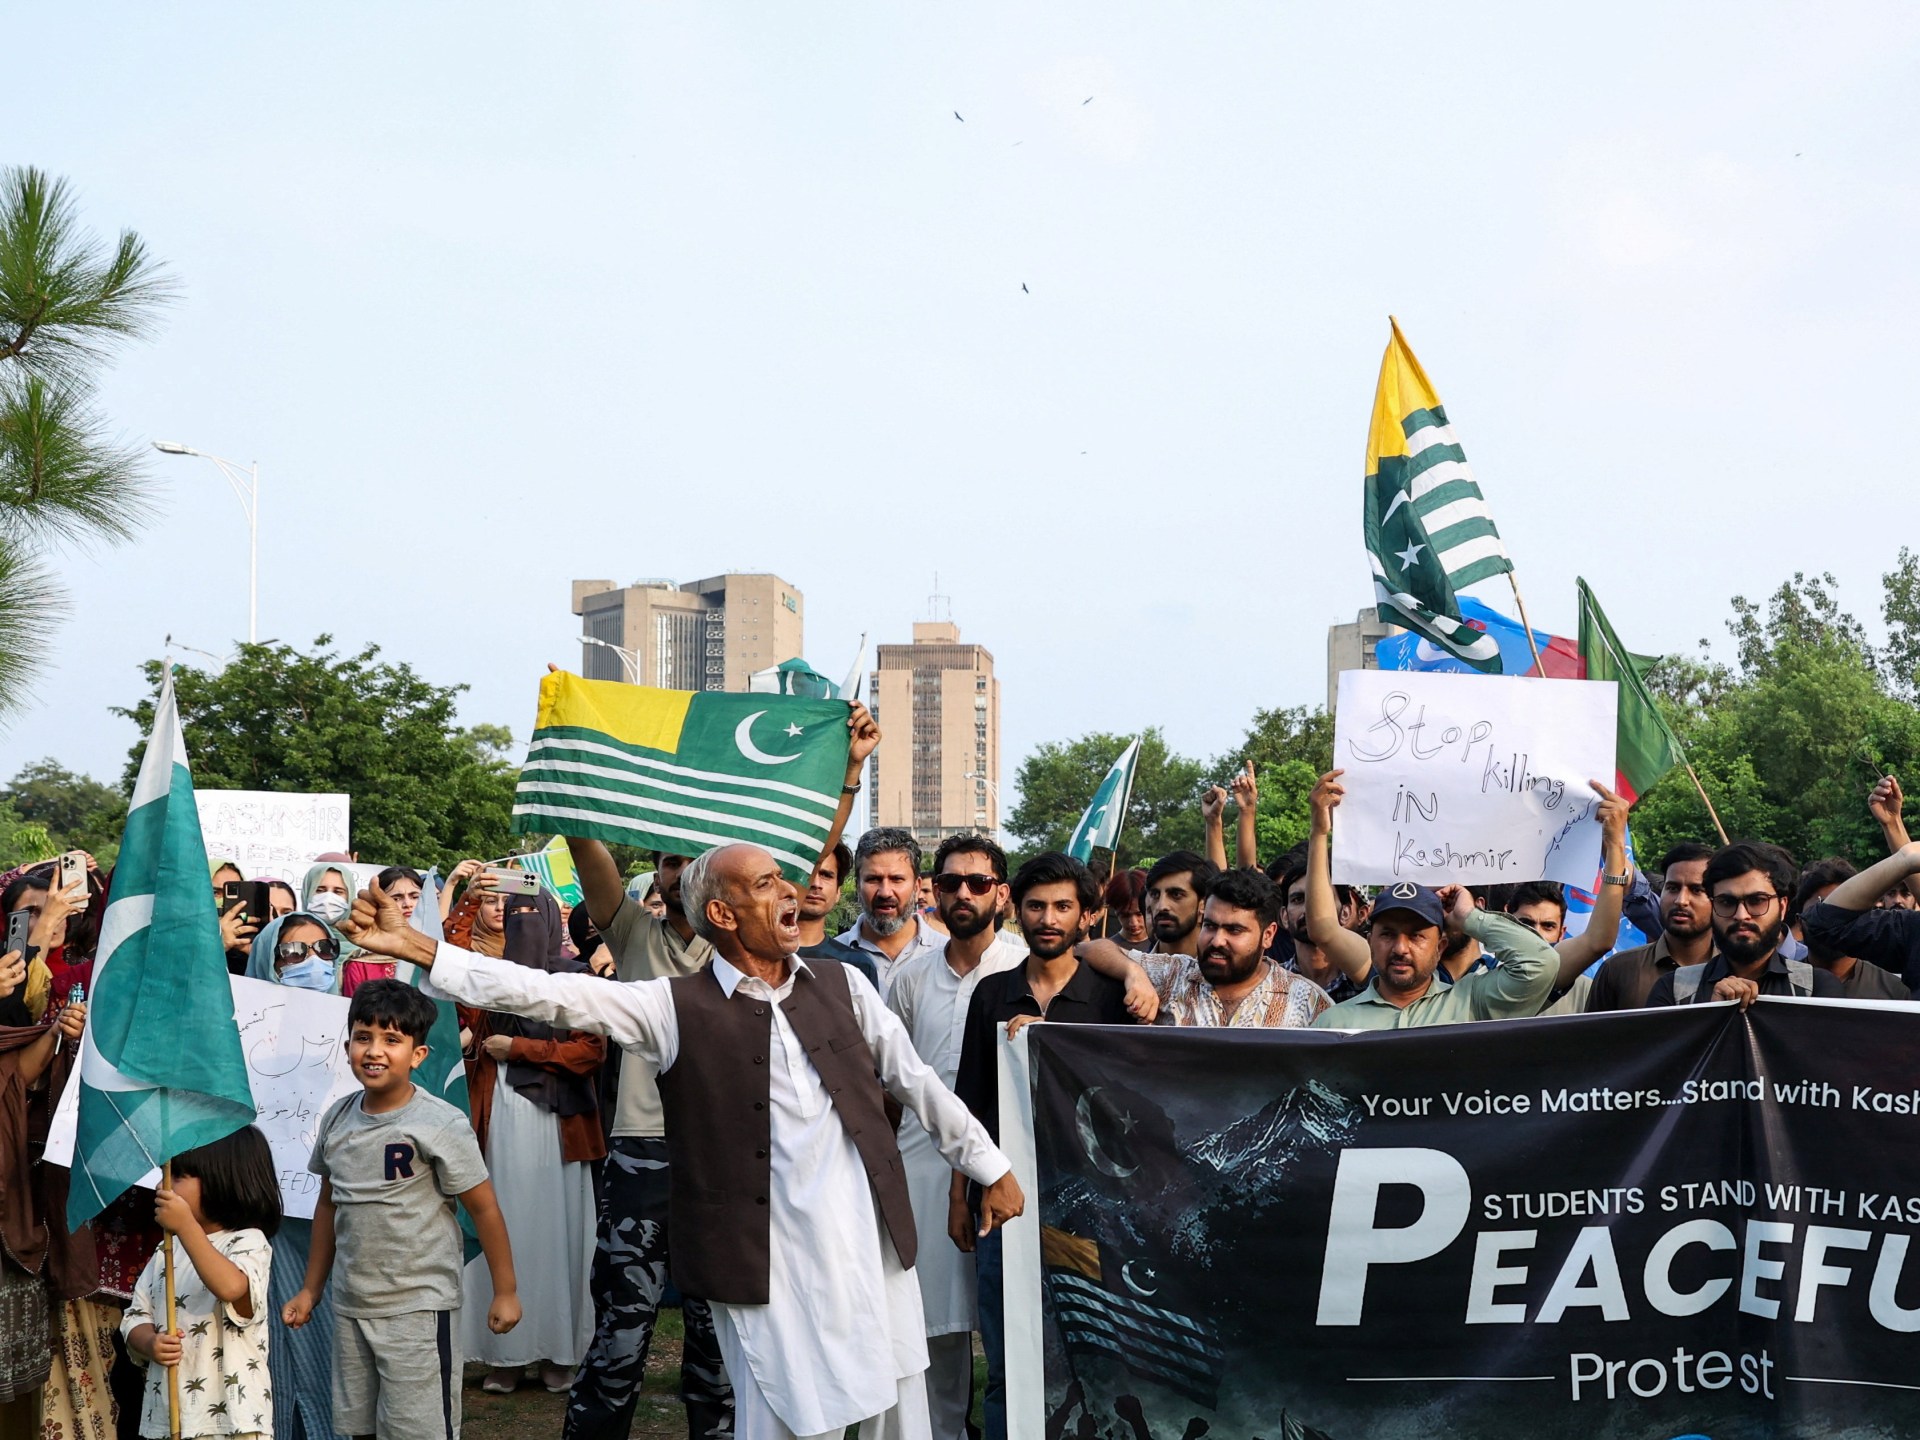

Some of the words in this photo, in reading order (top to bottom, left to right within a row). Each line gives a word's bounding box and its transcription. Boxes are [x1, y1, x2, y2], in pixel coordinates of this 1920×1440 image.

[1349, 690, 1493, 763] Stop
[1361, 1093, 1433, 1116] Your
[1441, 1089, 1531, 1115] Voice
[1773, 1079, 1841, 1108] with
[384, 1142, 415, 1181] R
[1483, 1187, 1646, 1220] STUDENTS
[1660, 1179, 1756, 1212] STAND
[1764, 1183, 1846, 1217] WITH
[1858, 1192, 1920, 1224] KAS
[1570, 1346, 1774, 1401] Protest
